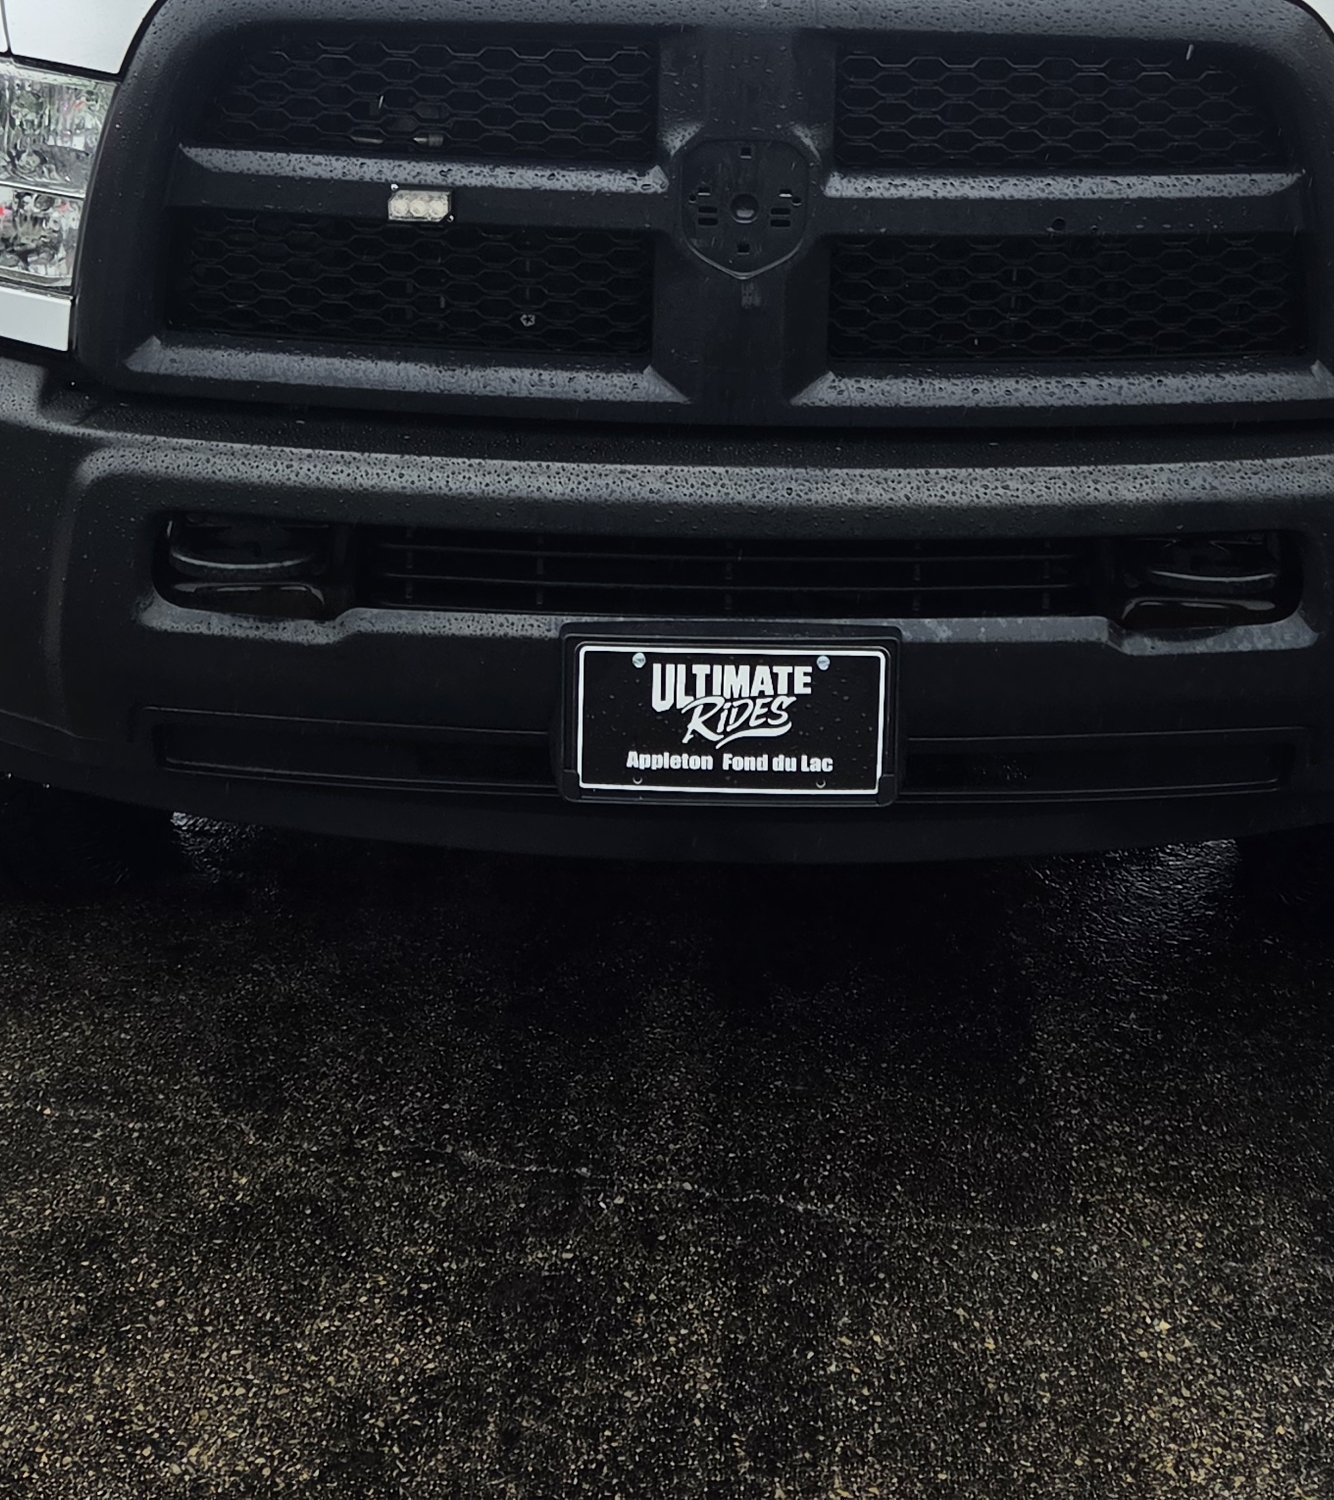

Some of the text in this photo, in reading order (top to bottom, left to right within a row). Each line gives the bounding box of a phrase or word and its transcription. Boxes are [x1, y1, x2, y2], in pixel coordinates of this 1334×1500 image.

[651, 663, 813, 712] ULTIMATE
[626, 751, 833, 772] Appleton Fond du Lac
